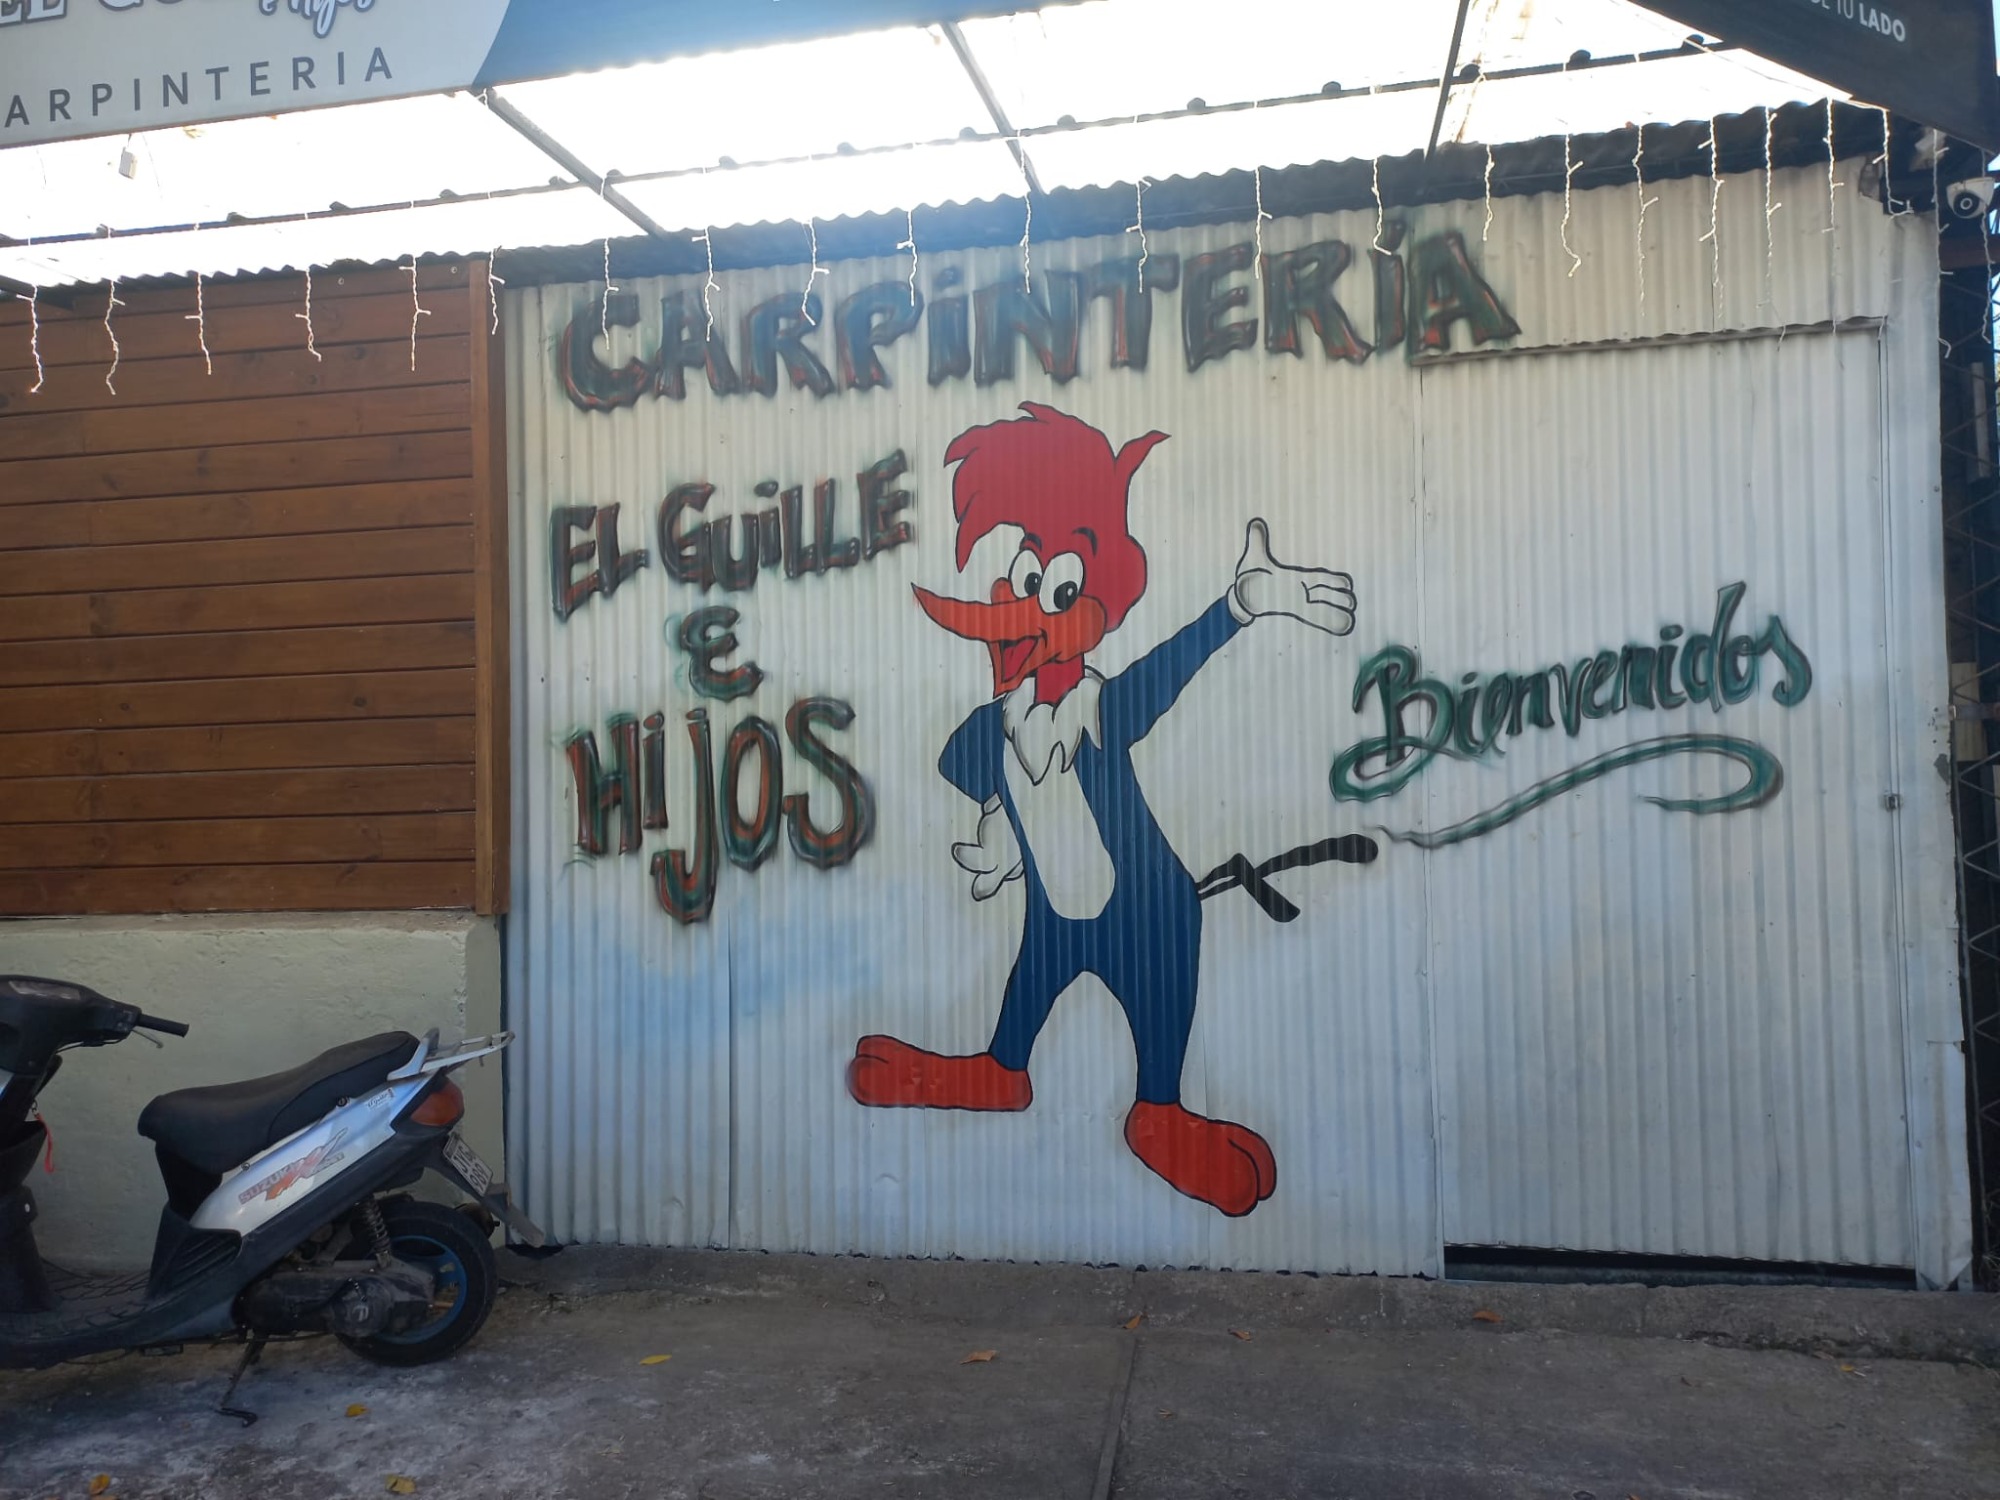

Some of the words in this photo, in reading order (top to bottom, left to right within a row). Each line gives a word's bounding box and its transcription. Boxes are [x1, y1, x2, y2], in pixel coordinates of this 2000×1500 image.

[1859, 2, 1906, 42] LADO
[549, 501, 650, 622] EL
[1329, 580, 1813, 802] Bienvenidos
